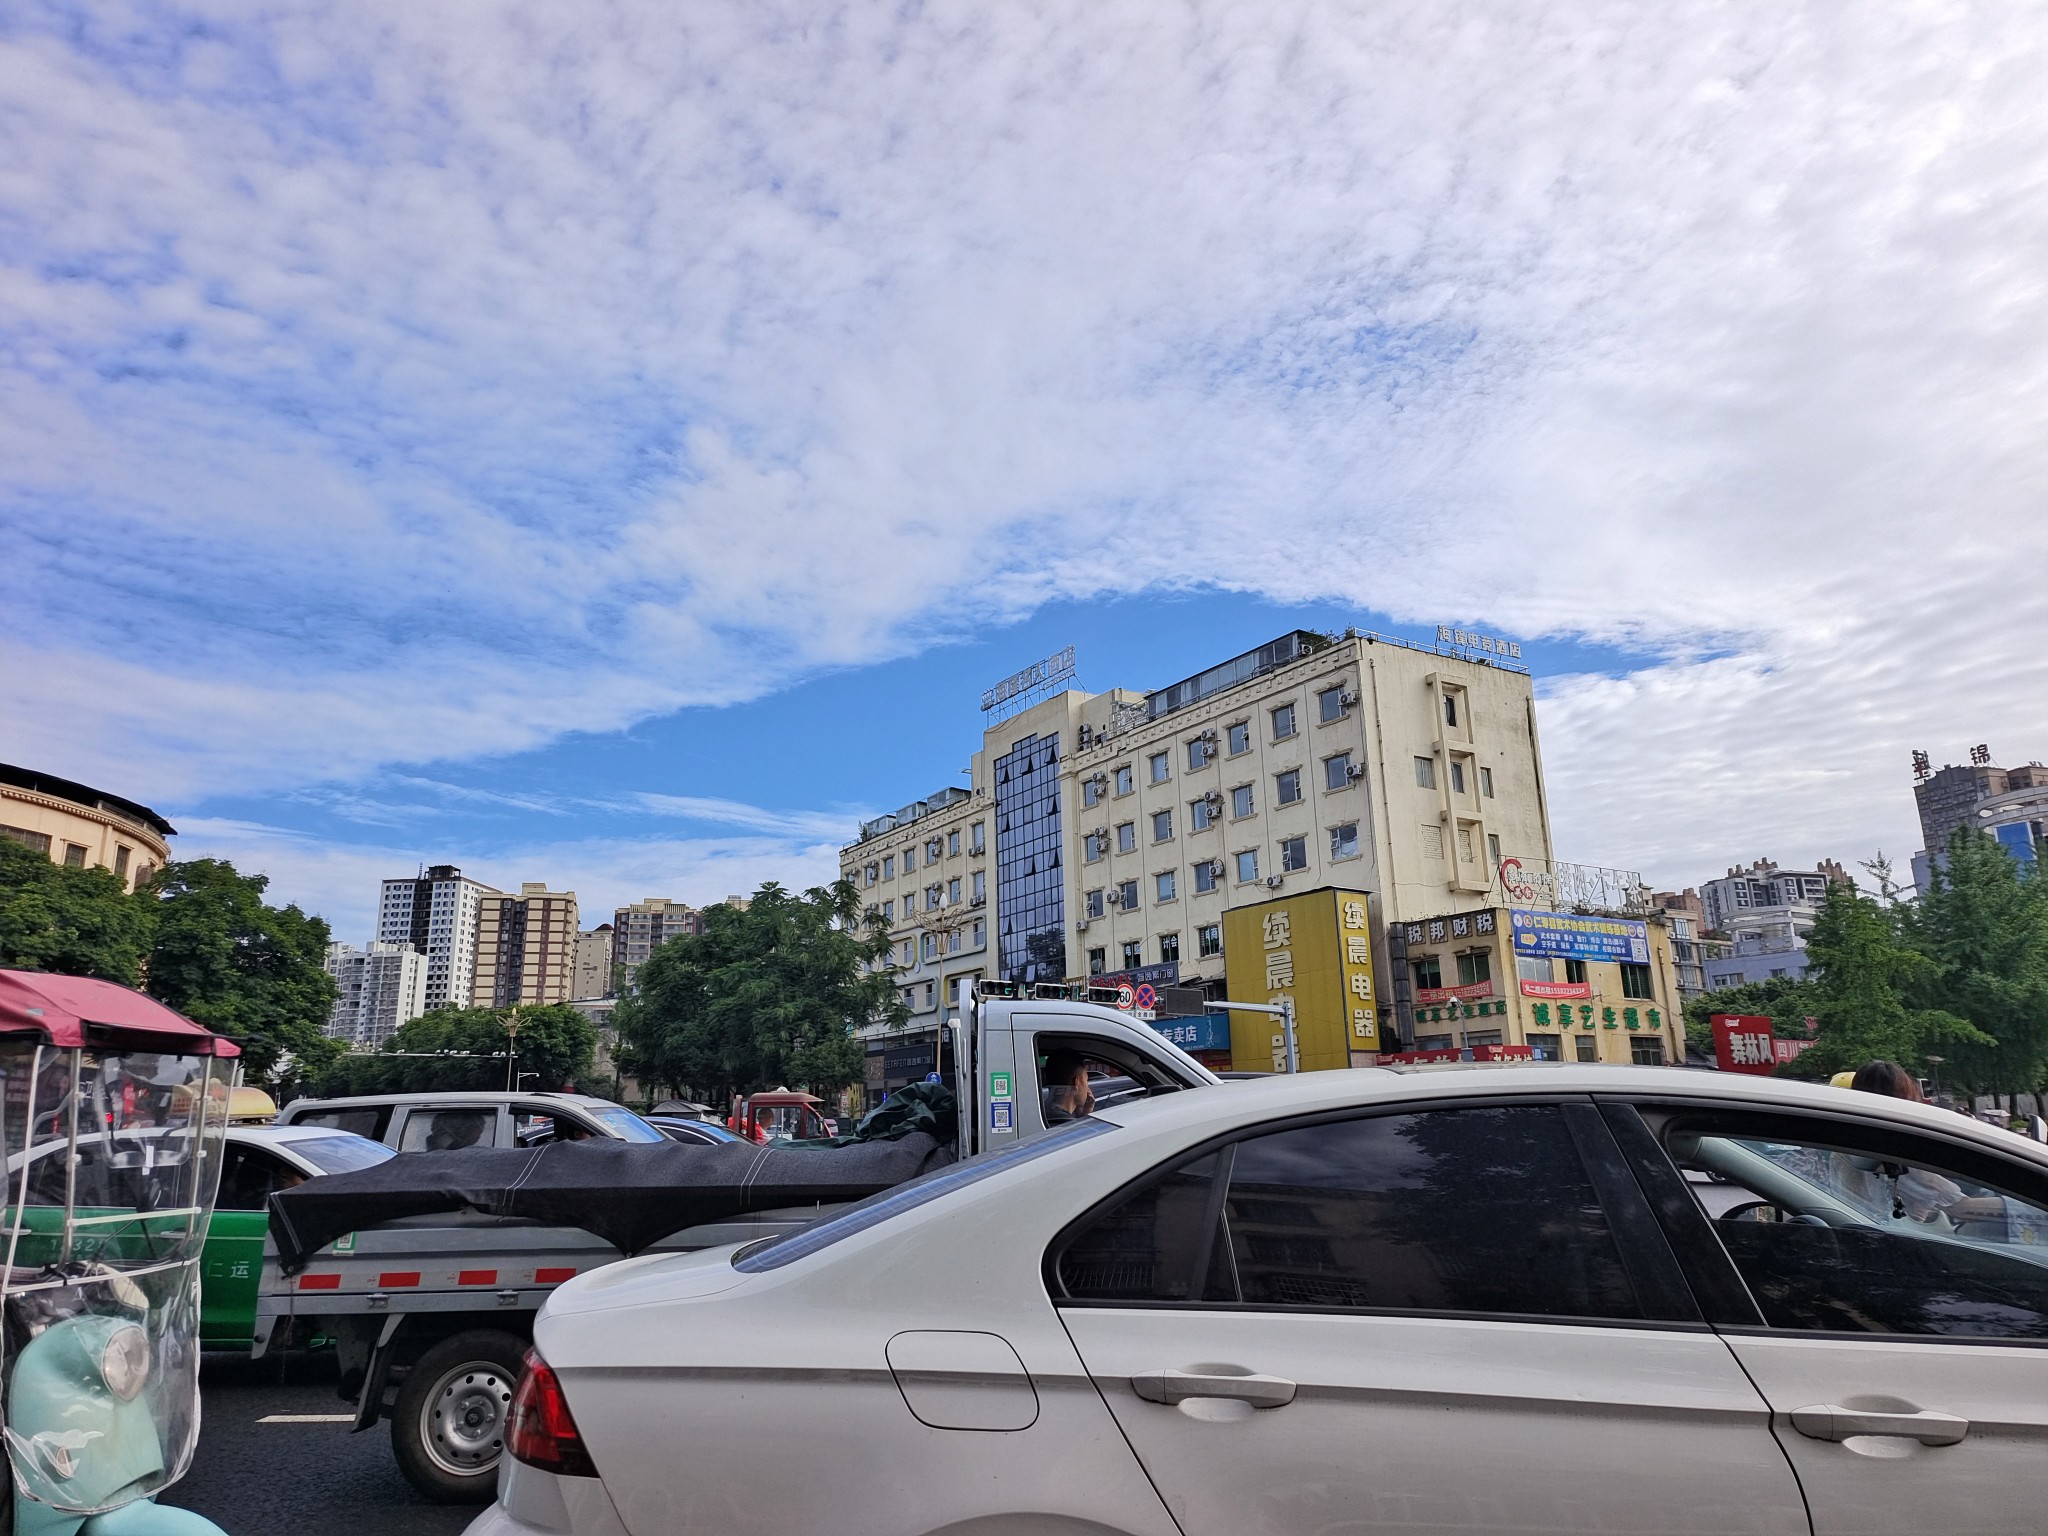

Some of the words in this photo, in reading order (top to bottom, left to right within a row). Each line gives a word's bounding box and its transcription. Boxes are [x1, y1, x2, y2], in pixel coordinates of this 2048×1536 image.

[1407, 913, 1493, 943] 税邦财税
[1345, 901, 1375, 1038] 续晨电器
[1119, 991, 1131, 1003] 60
[1262, 911, 1300, 1073] 续晨电器
[1729, 1031, 1775, 1065] 舞林风
